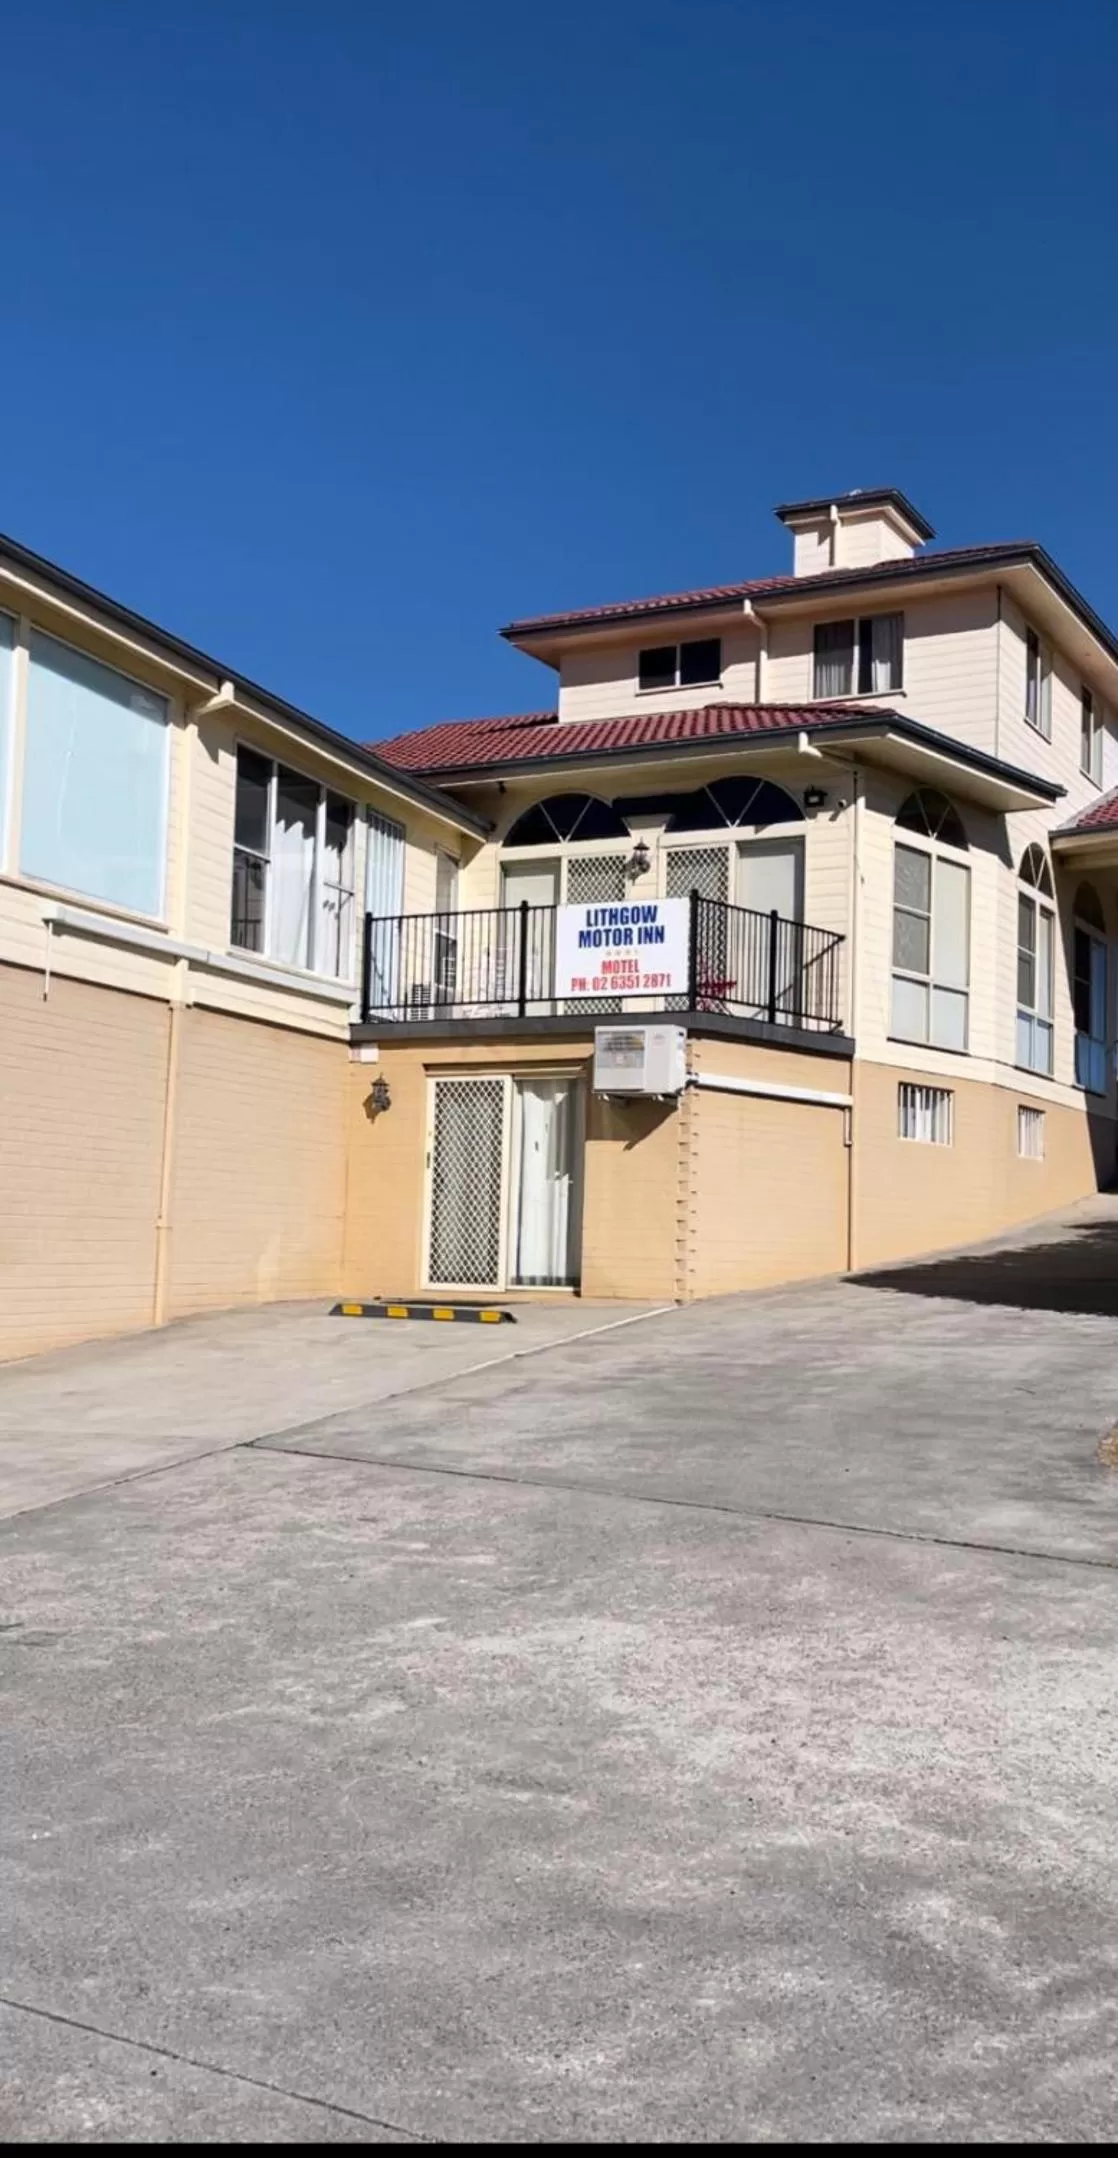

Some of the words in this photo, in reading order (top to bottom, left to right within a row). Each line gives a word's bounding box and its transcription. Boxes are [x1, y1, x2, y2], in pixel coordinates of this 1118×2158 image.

[586, 905, 657, 927] LITHGOW
[578, 927, 633, 948] MOTOR
[637, 925, 665, 945] INN
[601, 959, 640, 974] MOTEL
[592, 976, 608, 991] 02
[610, 974, 640, 990] 6351
[643, 973, 672, 989] 2871
